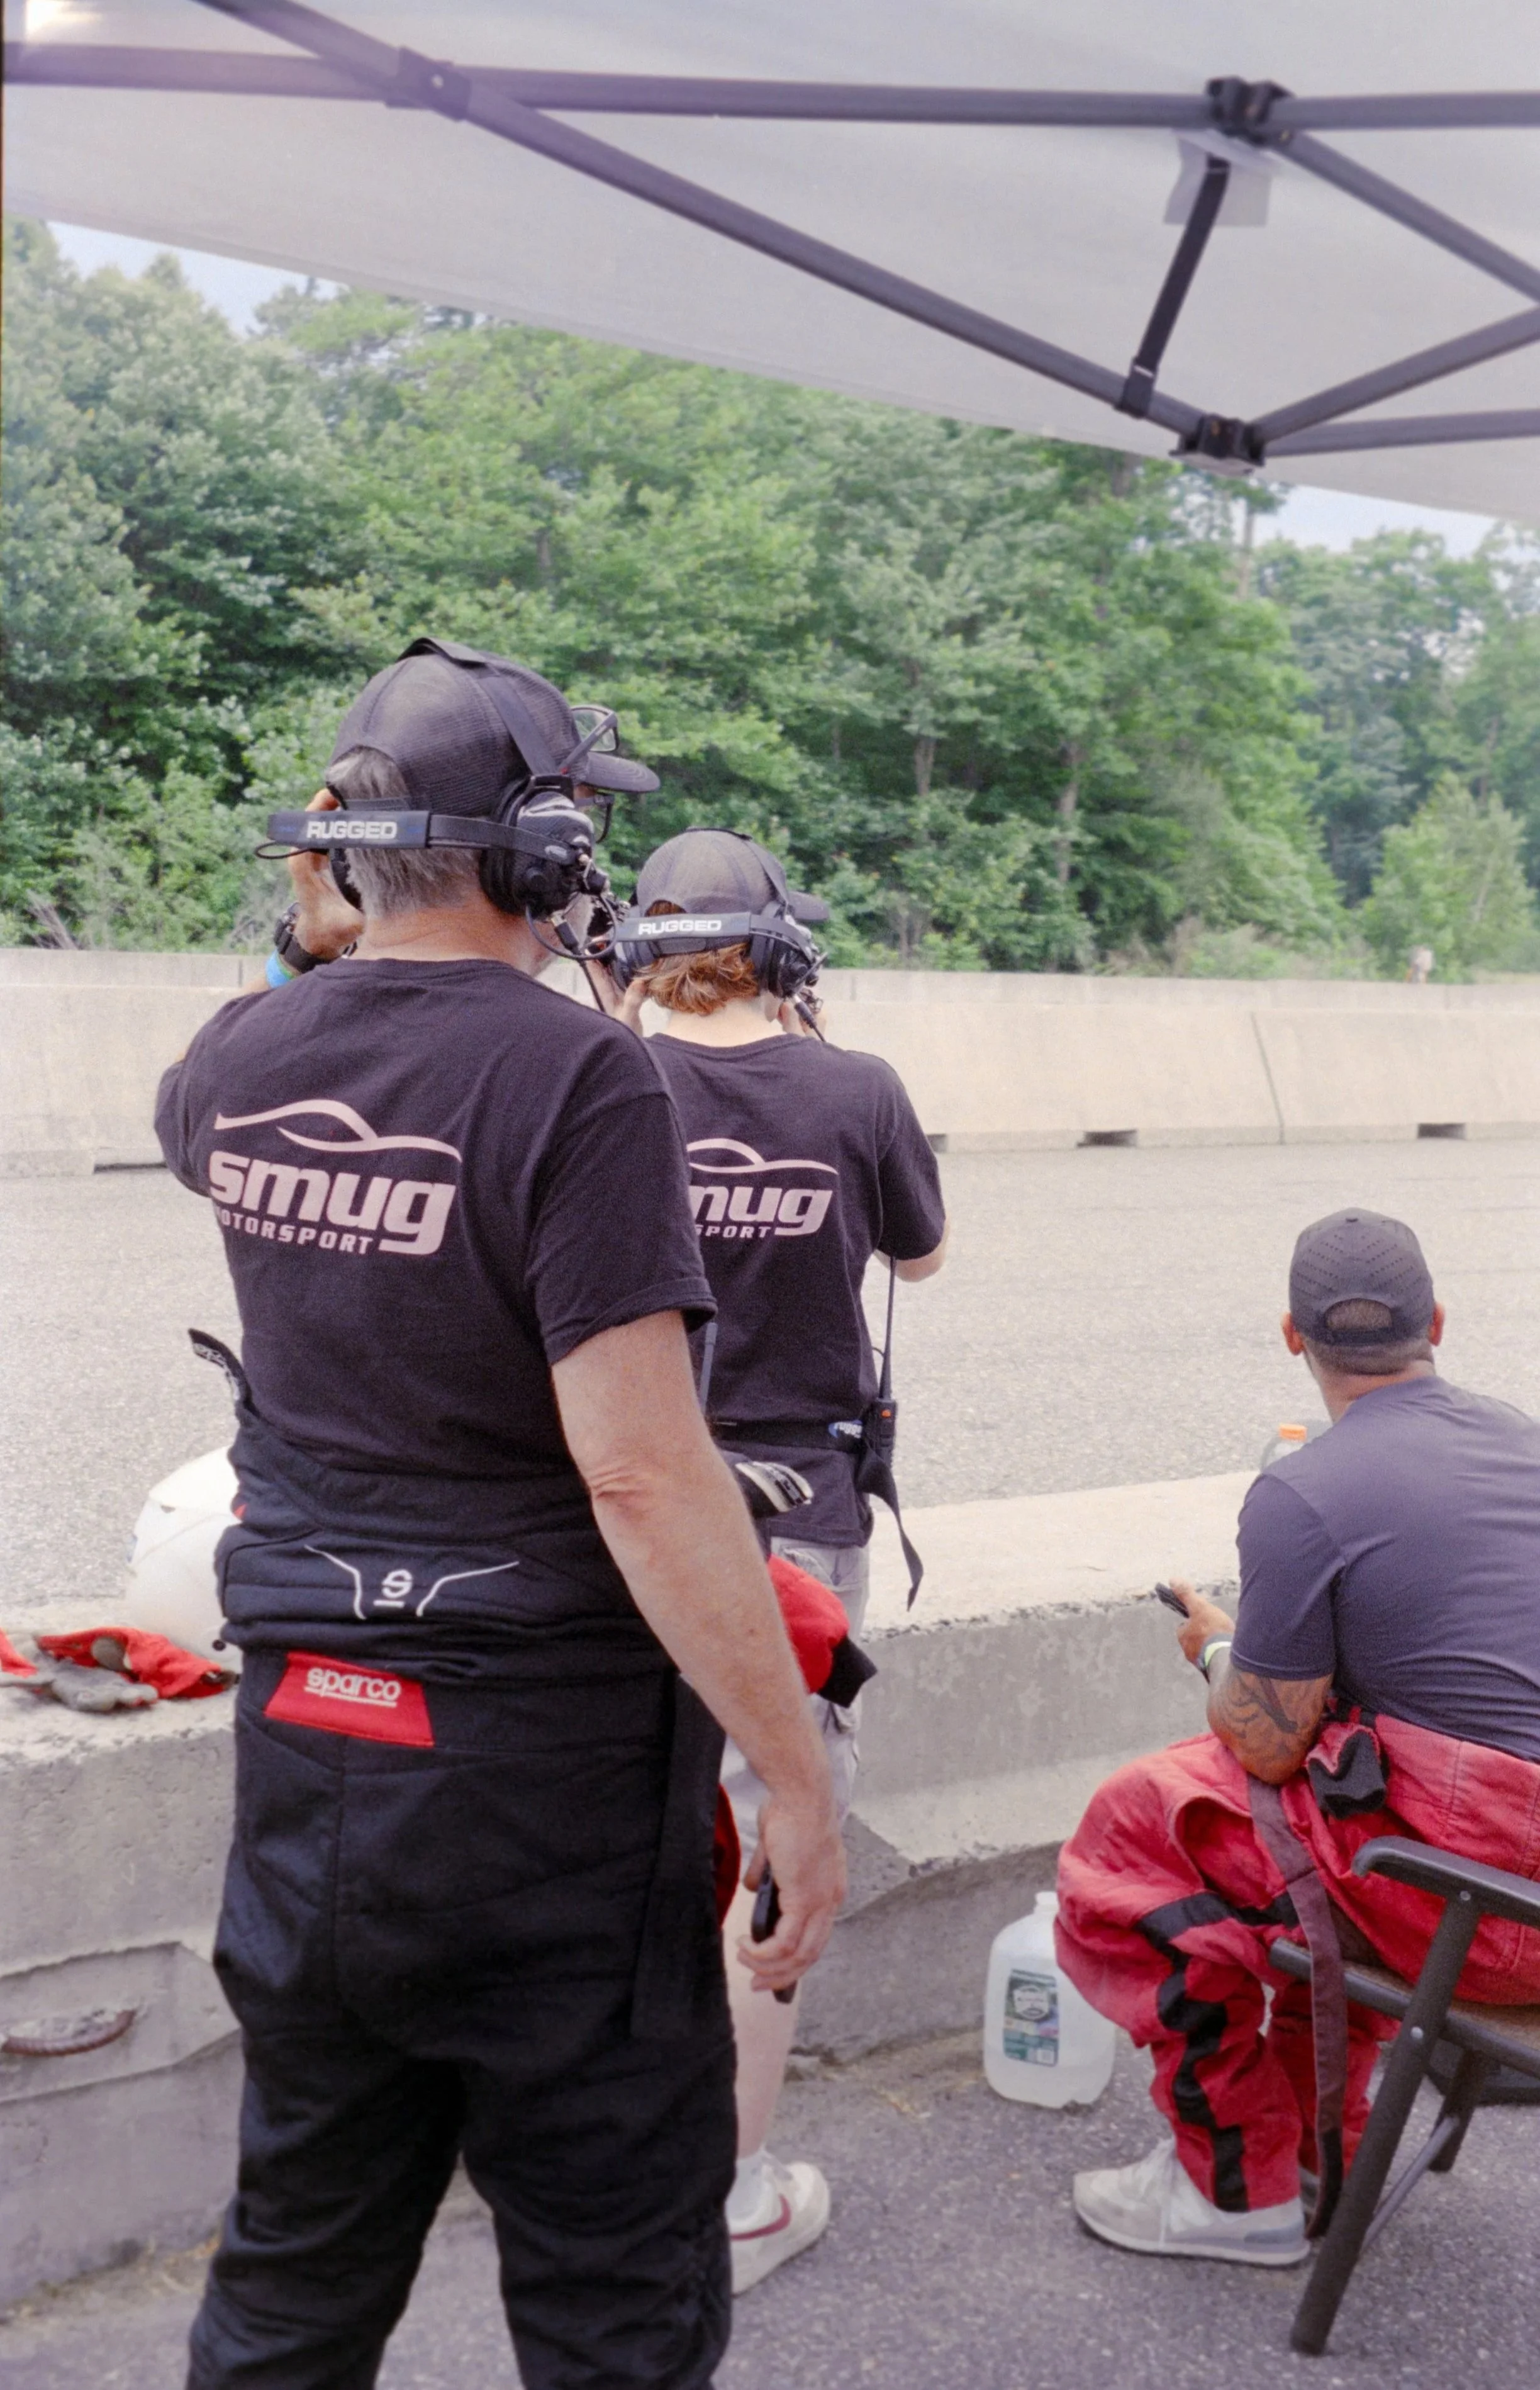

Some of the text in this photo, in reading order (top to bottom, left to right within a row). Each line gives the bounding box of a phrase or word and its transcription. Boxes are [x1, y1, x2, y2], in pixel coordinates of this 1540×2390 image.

[306, 821, 398, 839] RUGGED
[638, 919, 722, 935] RUGGED
[209, 1150, 456, 1255] smug
[688, 1186, 833, 1235] mug
[307, 1668, 401, 1700] sparco
